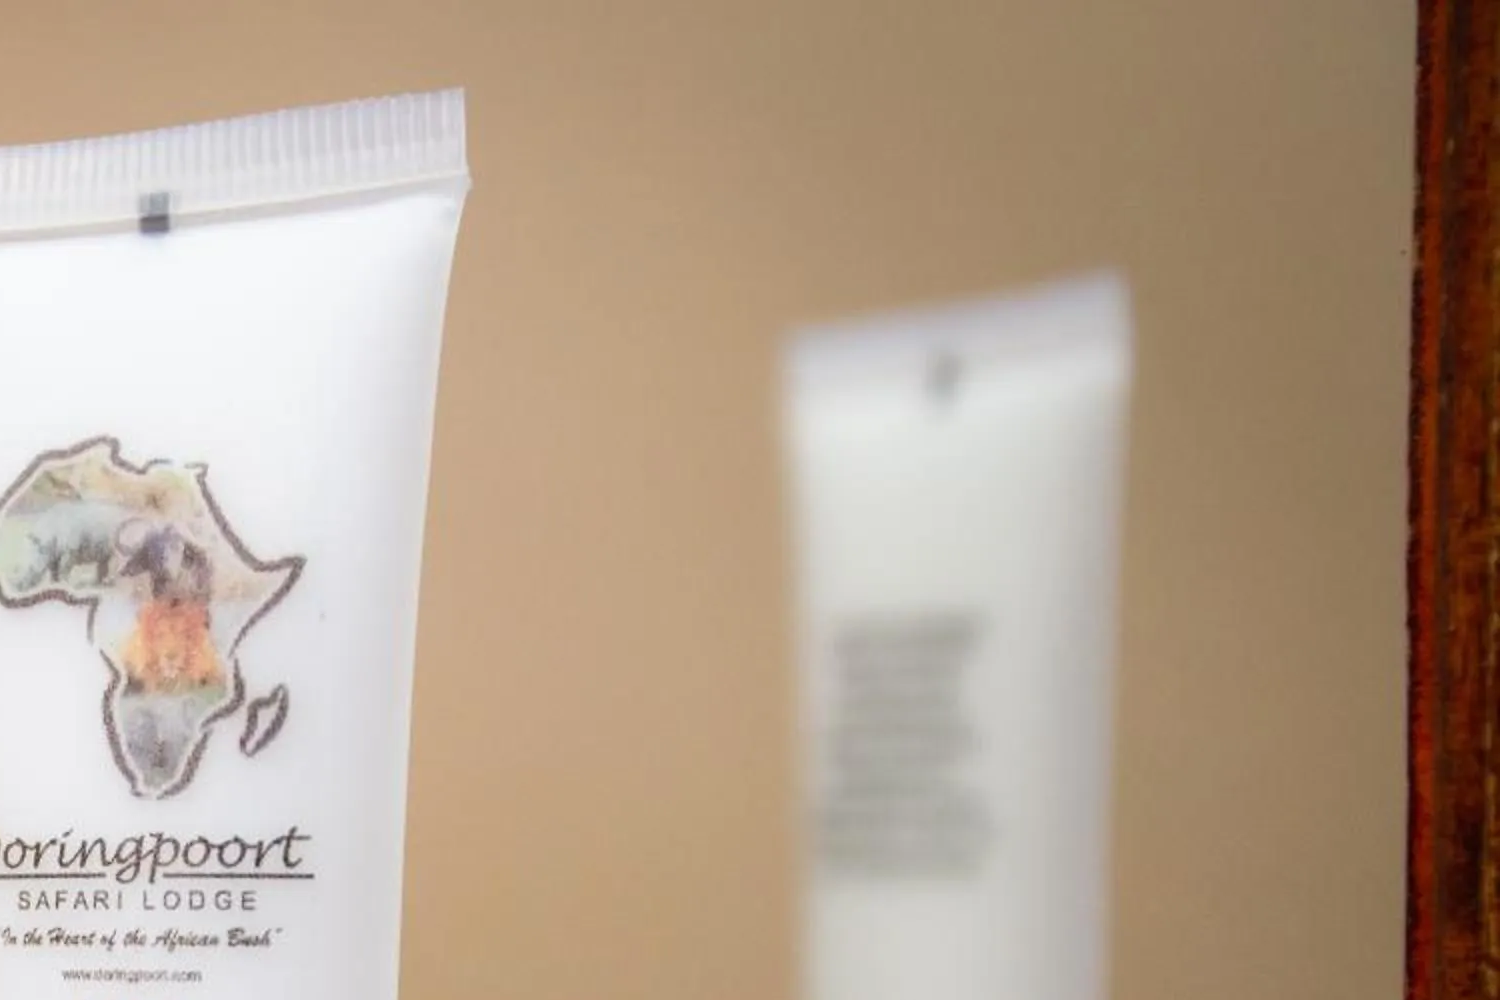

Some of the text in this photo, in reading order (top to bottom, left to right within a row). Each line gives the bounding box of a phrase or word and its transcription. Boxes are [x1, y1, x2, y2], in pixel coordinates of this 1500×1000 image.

[17, 890, 258, 911] SAFARI LODGE
[23, 928, 42, 946] the
[47, 927, 94, 947] Heart
[100, 930, 117, 951] of
[122, 929, 145, 947] the
[150, 927, 219, 951] African
